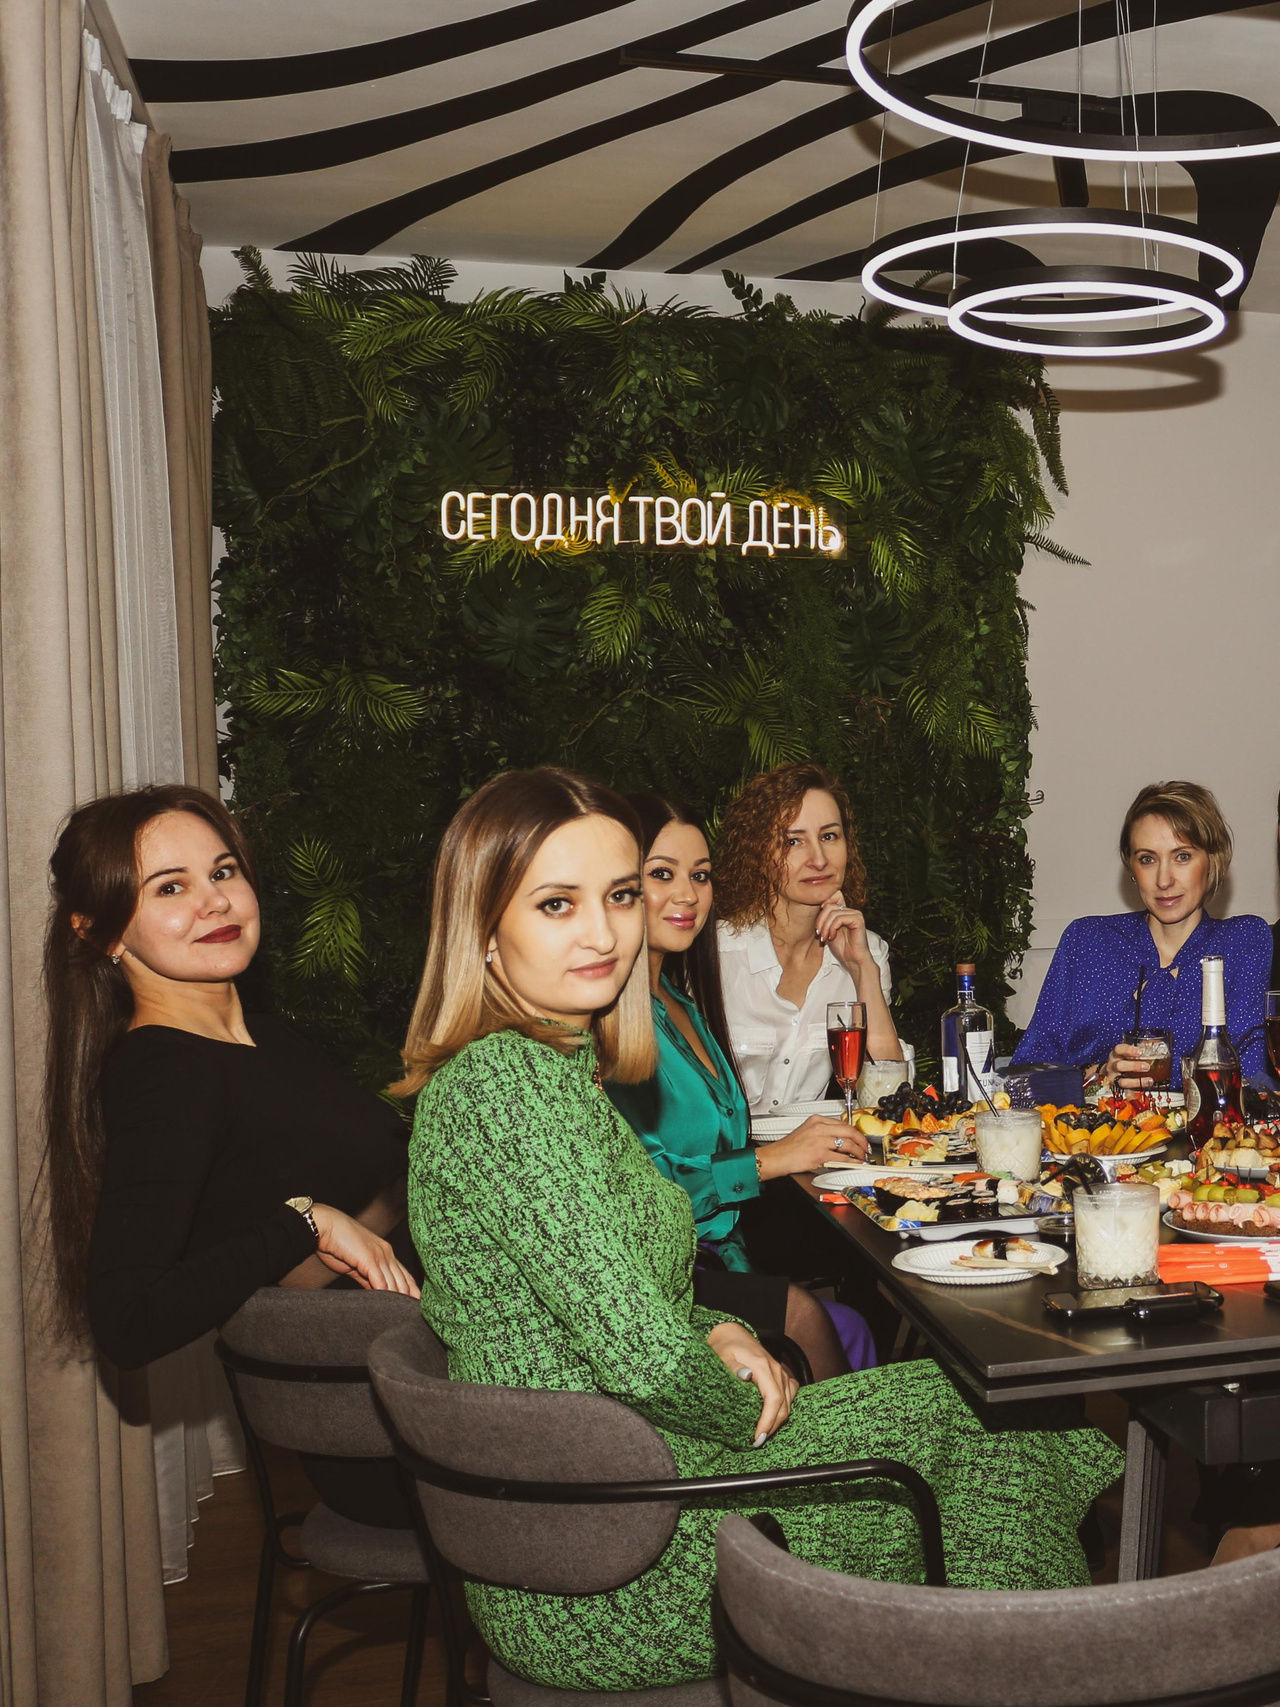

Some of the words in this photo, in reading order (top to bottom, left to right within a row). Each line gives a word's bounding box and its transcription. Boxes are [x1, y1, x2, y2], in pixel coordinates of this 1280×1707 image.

[440, 491, 619, 550] СЕГОДНЯ
[629, 492, 732, 545] ТВОЙ
[741, 500, 842, 556] ДЕНЬ
